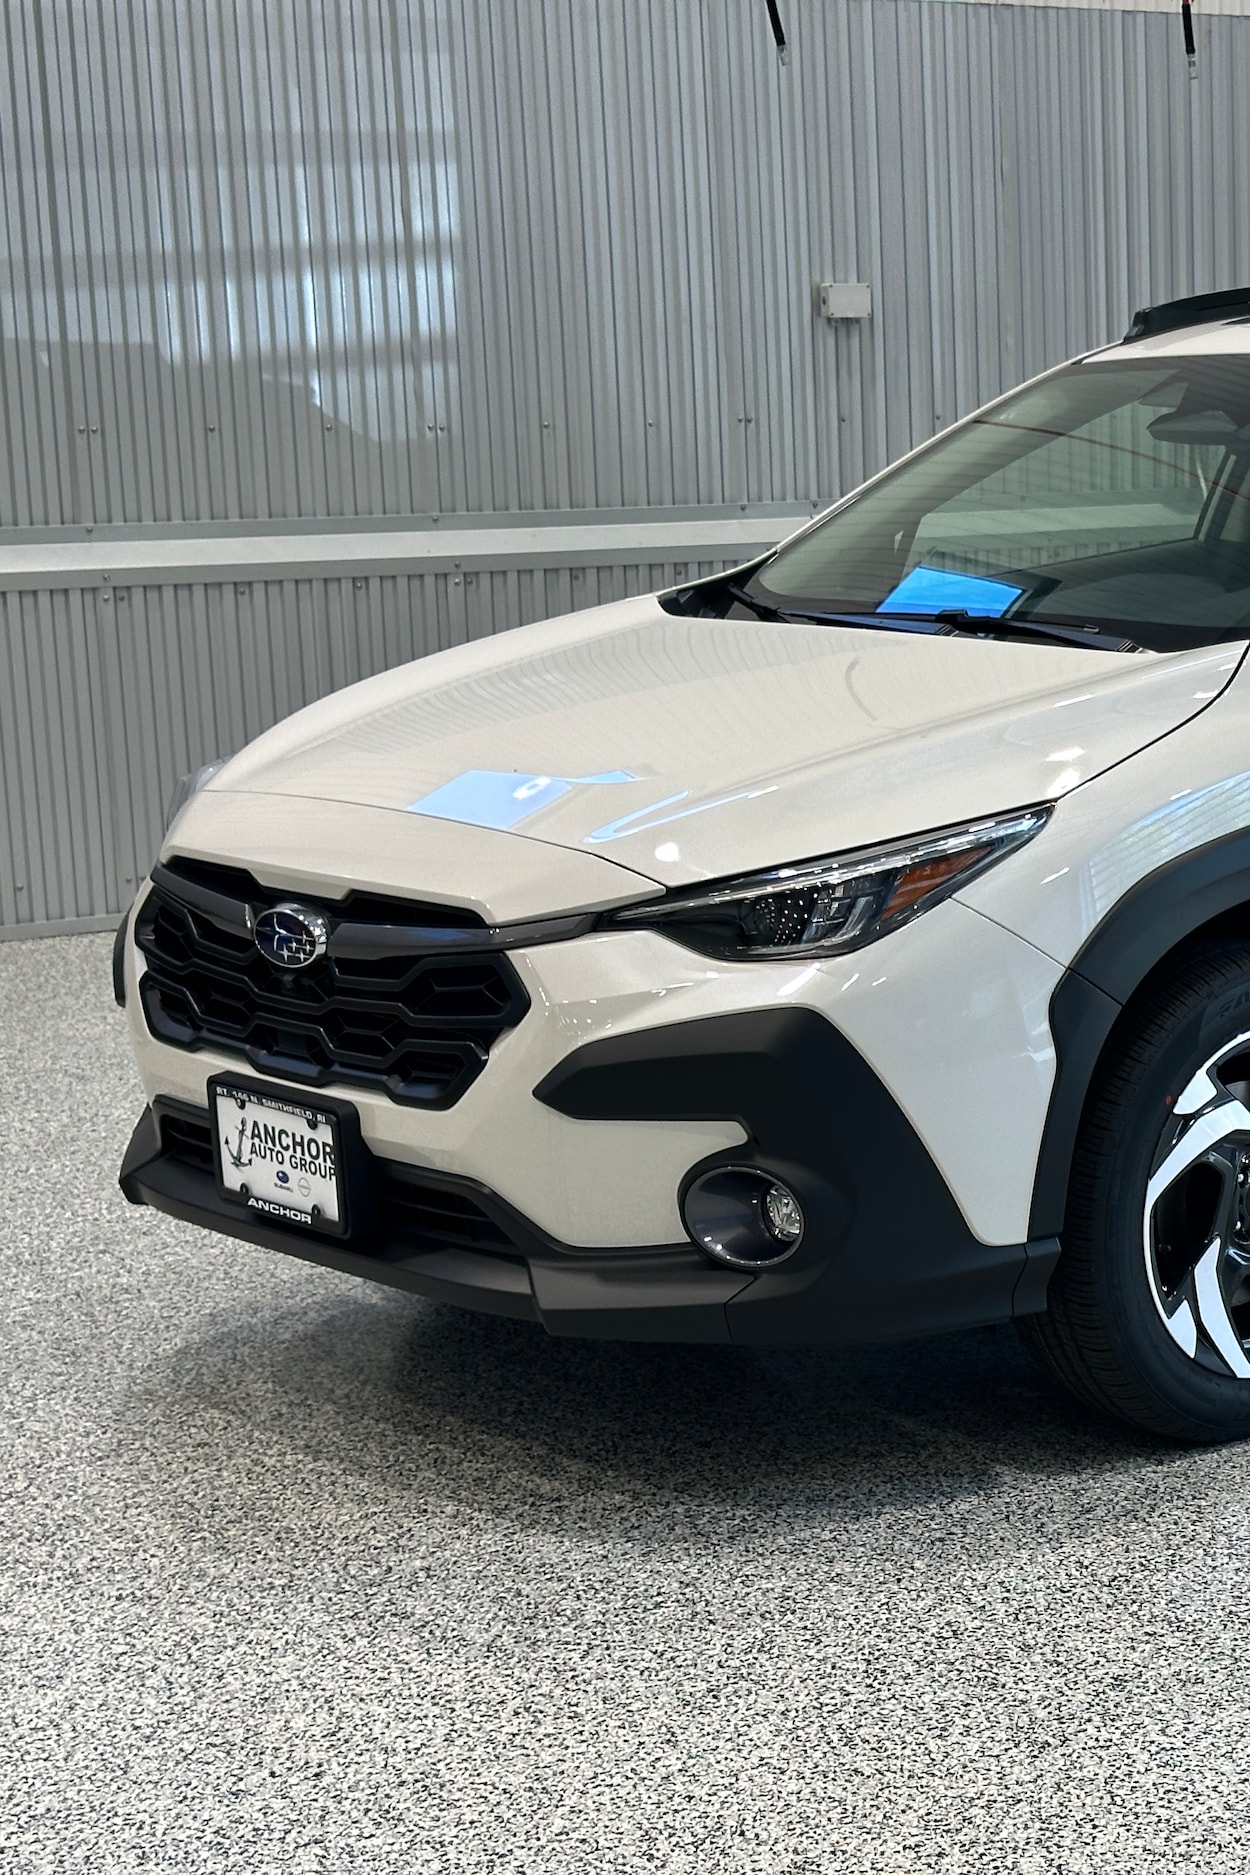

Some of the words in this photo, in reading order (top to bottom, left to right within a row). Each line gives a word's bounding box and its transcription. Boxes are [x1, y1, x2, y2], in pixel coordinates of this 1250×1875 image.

[250, 1142, 285, 1165] AUTO
[289, 1155, 336, 1181] GROUP
[251, 1120, 335, 1166] ANCHOR
[248, 1197, 312, 1225] ANCHOR
